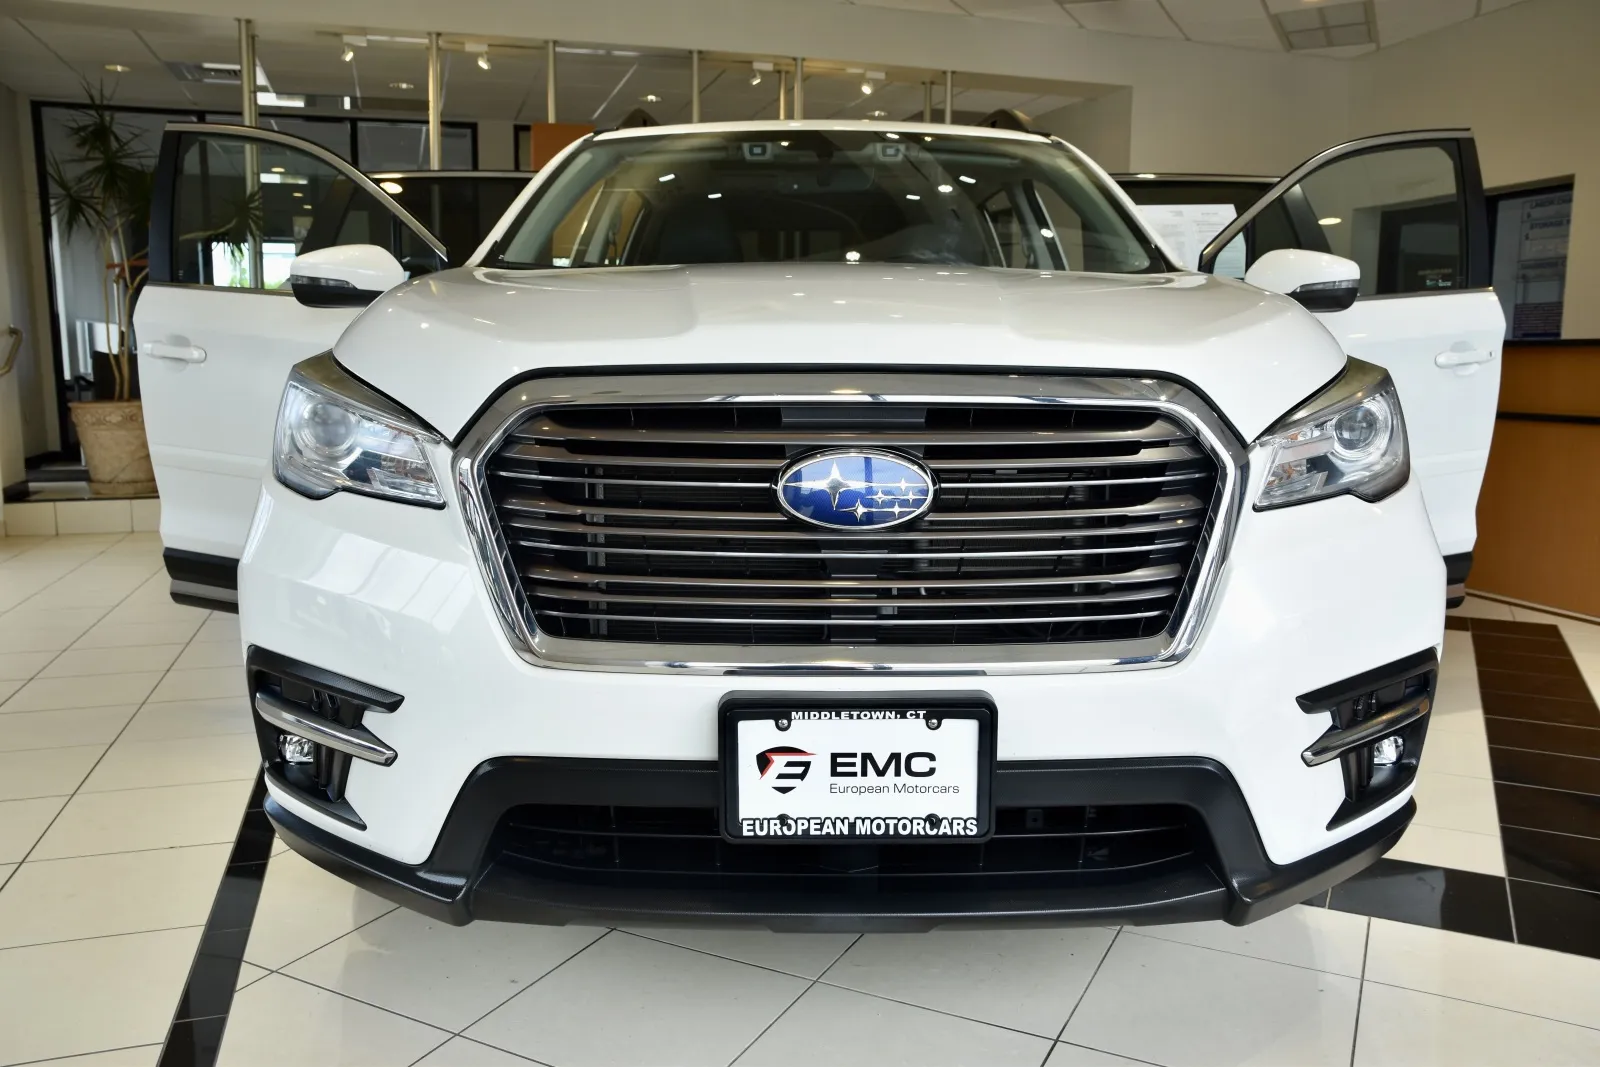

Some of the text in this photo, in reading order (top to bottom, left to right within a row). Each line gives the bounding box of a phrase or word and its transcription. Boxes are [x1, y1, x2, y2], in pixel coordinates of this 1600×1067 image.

[791, 710, 927, 720] MIDDLETOWN, CT
[830, 752, 937, 778] EMC
[829, 783, 960, 796] European Motorcars
[742, 818, 978, 836] EUROPEAN MOTORCARS
